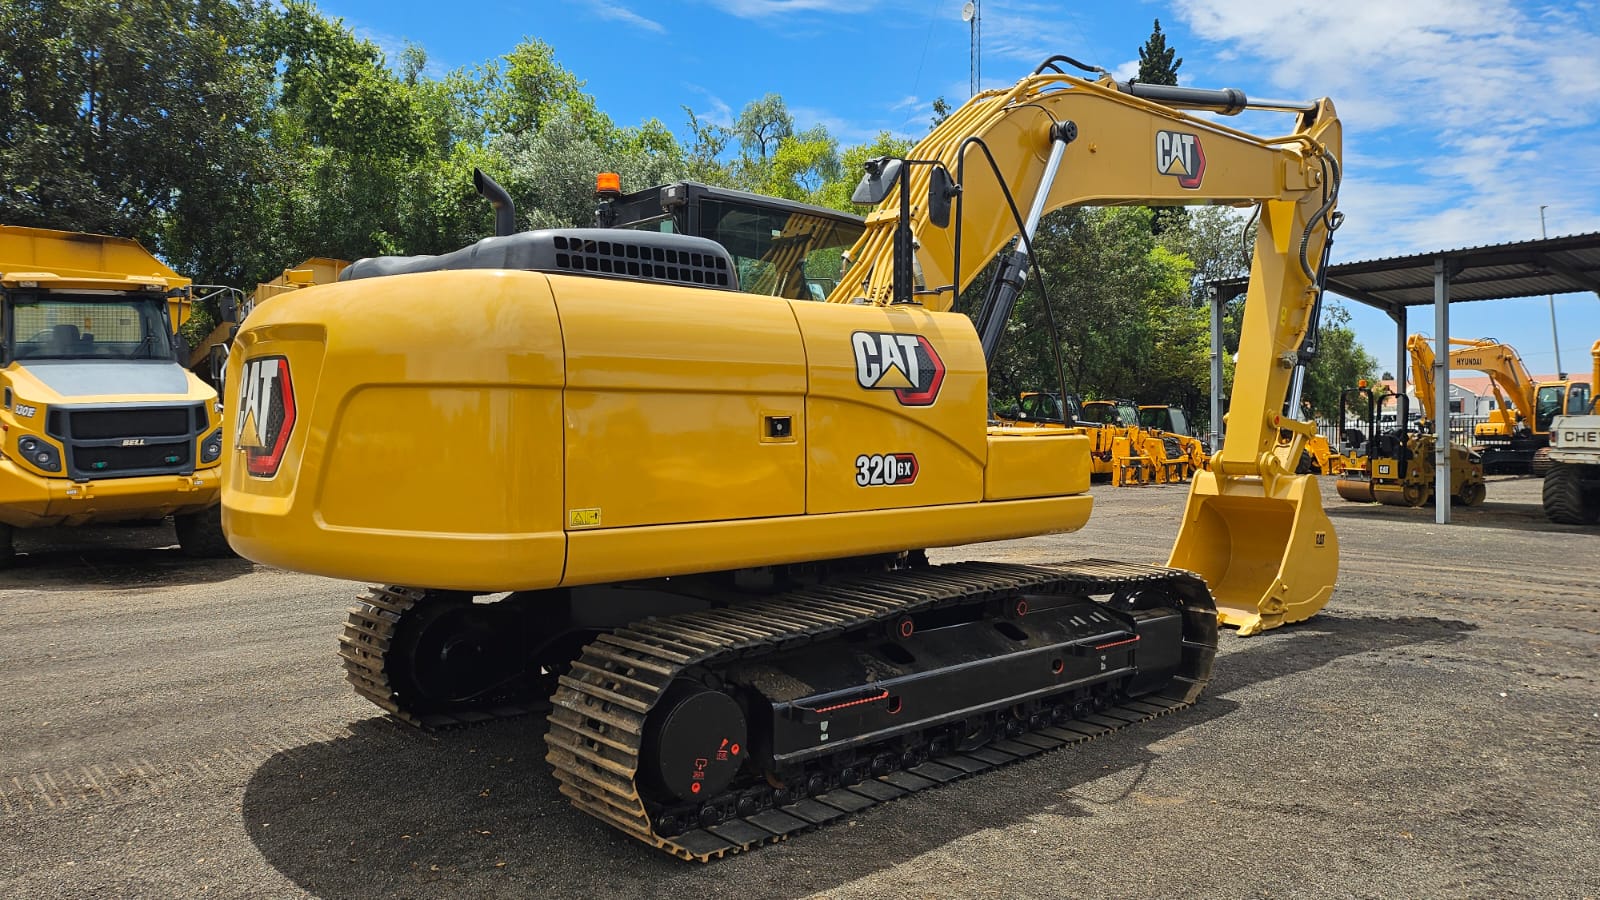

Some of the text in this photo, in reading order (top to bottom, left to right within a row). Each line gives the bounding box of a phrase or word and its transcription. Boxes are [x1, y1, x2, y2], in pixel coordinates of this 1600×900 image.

[1156, 131, 1195, 176] CAT
[851, 331, 920, 388] CAT
[1456, 357, 1482, 366] HYUNDAI
[235, 359, 279, 447] CAT
[122, 438, 145, 446] BELL
[1564, 431, 1600, 442] CHE
